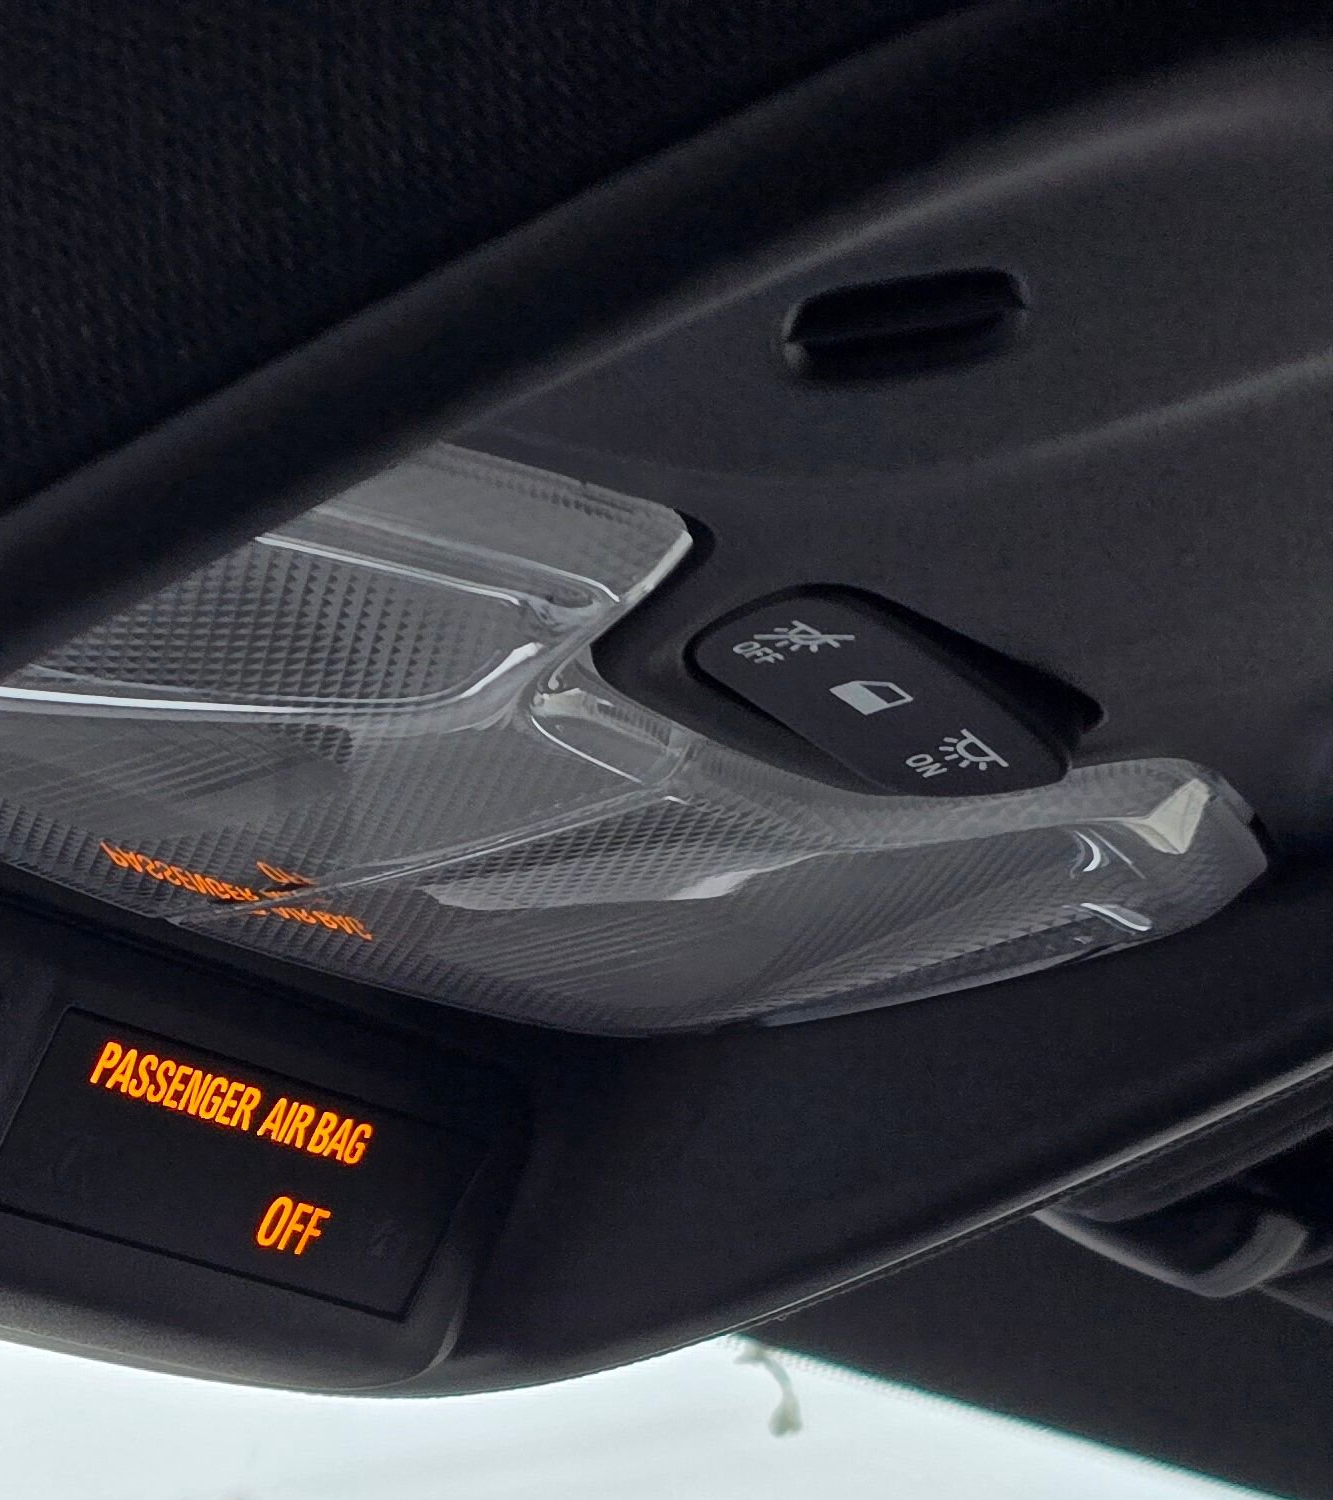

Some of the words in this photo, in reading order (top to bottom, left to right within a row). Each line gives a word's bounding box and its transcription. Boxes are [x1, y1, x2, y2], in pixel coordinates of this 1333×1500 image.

[732, 641, 785, 664] OFF
[905, 753, 948, 778] ON
[89, 1041, 262, 1131] PASSENGER
[256, 1196, 331, 1255] OFF
